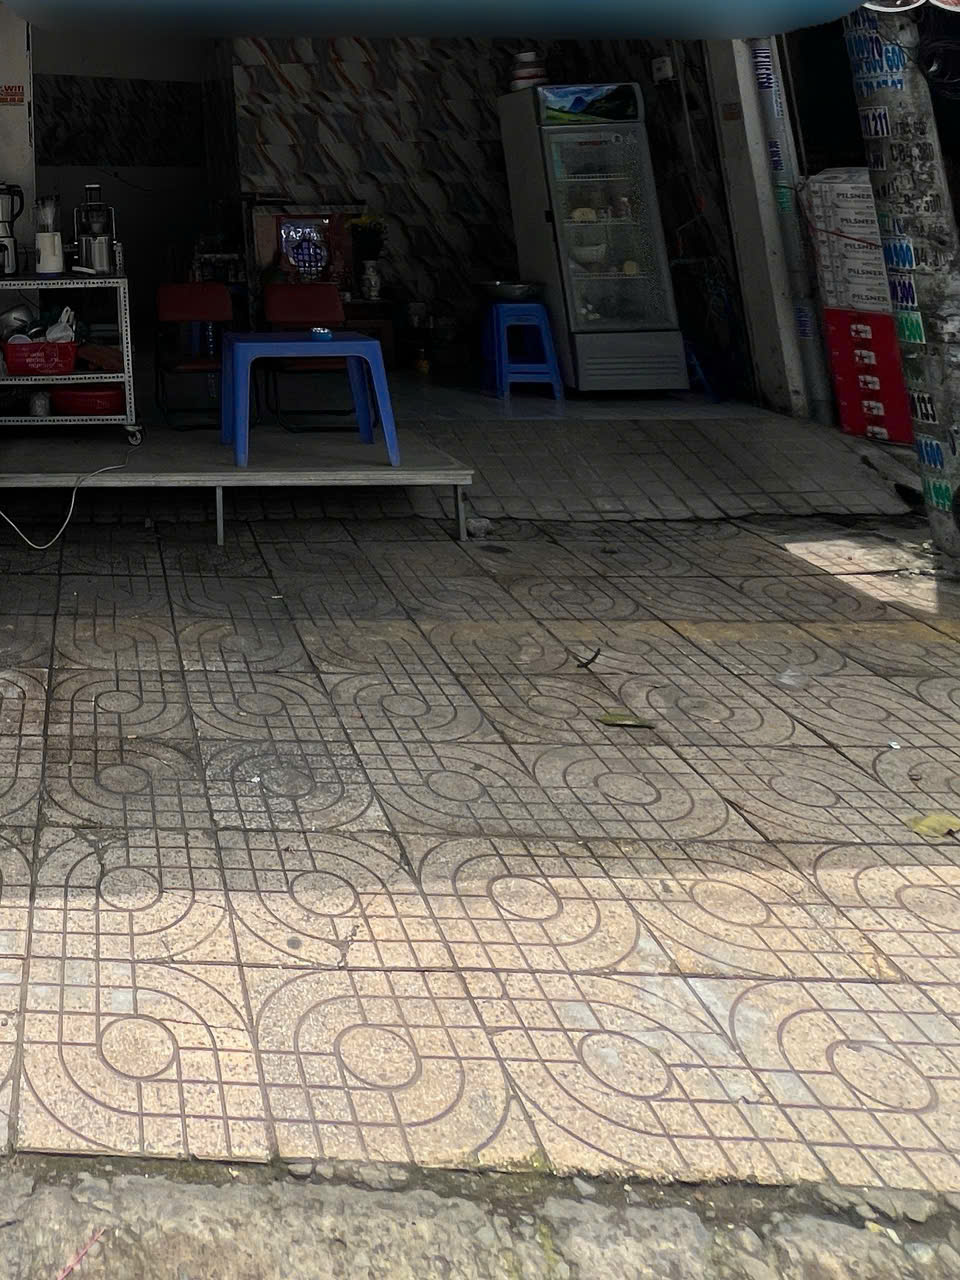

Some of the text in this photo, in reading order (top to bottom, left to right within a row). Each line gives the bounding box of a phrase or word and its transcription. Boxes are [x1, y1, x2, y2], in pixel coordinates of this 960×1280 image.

[836, 192, 873, 200] PILSNER
[839, 217, 877, 225] PILSNER
[847, 267, 885, 276] PILSNER
[851, 293, 889, 302] PILSNER
